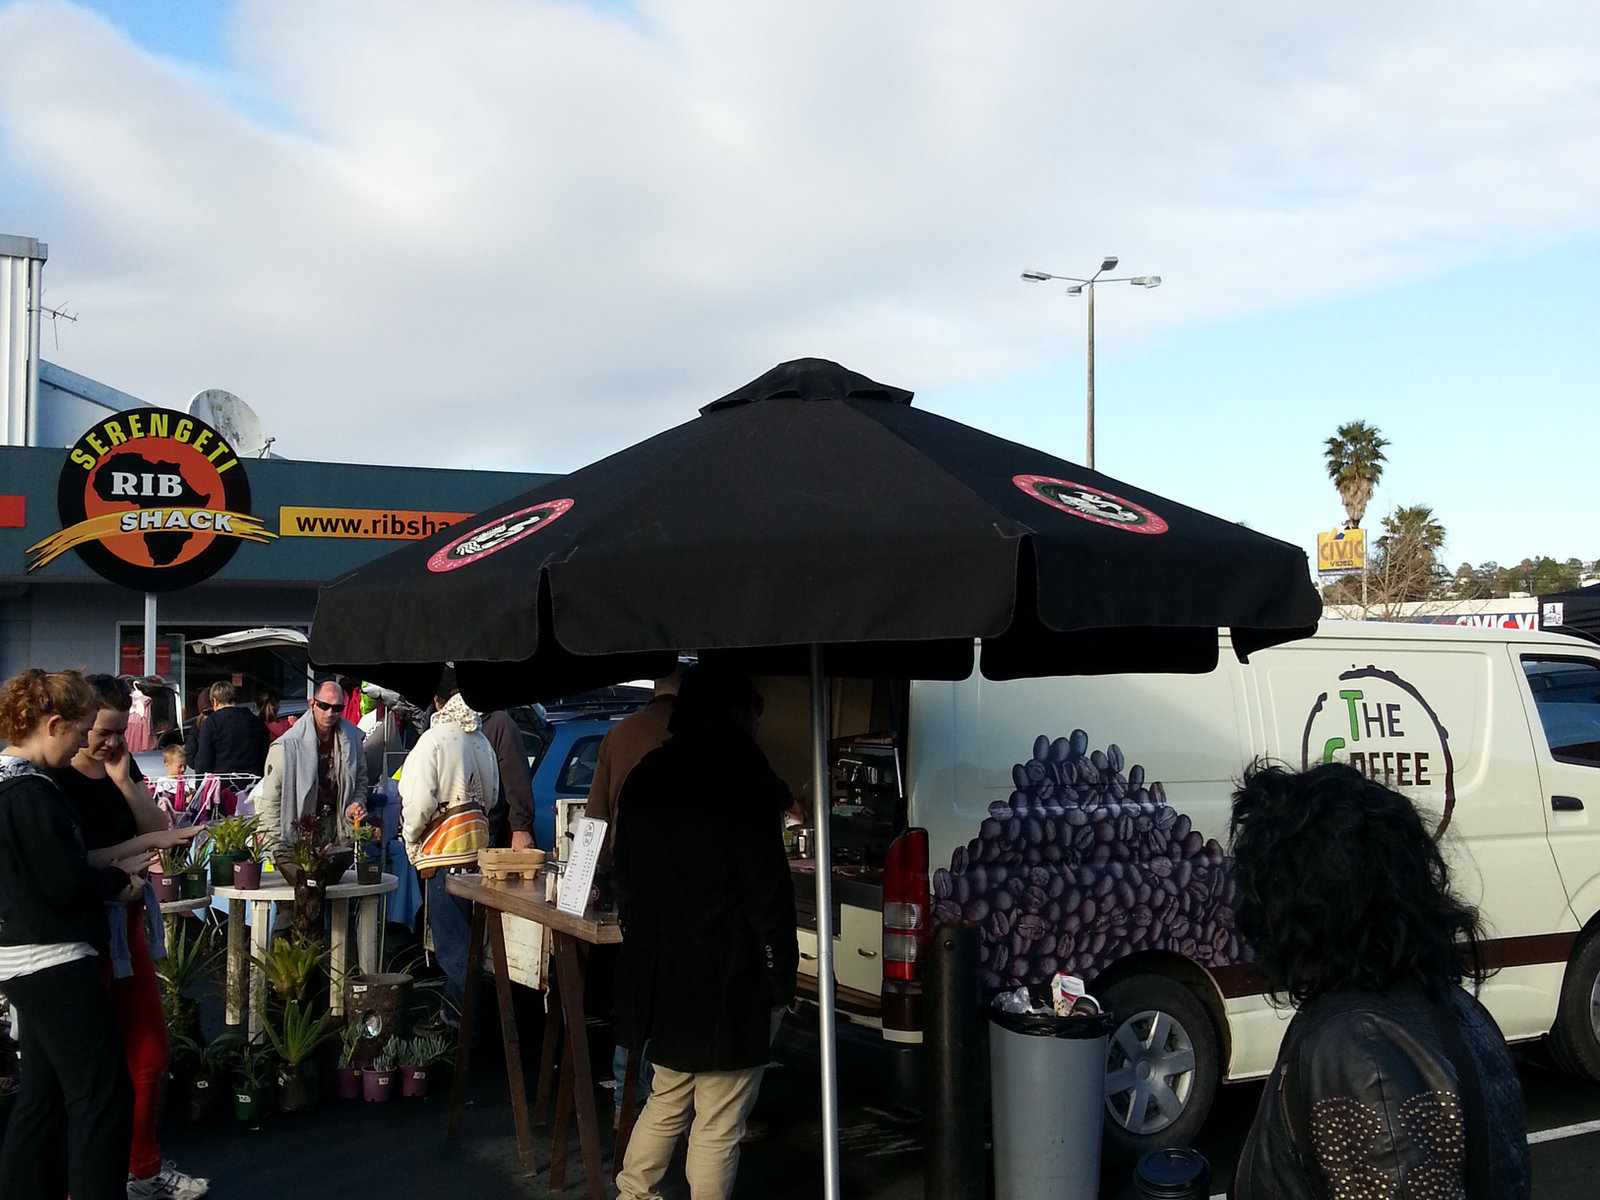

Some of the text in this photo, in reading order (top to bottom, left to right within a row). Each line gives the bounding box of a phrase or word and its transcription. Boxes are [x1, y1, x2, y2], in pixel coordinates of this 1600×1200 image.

[70, 413, 238, 474] SERENGETI
[111, 472, 183, 497] RIB
[121, 510, 233, 533] SHACK
[1320, 540, 1363, 561] CIVIC
[1339, 690, 1404, 741] THE
